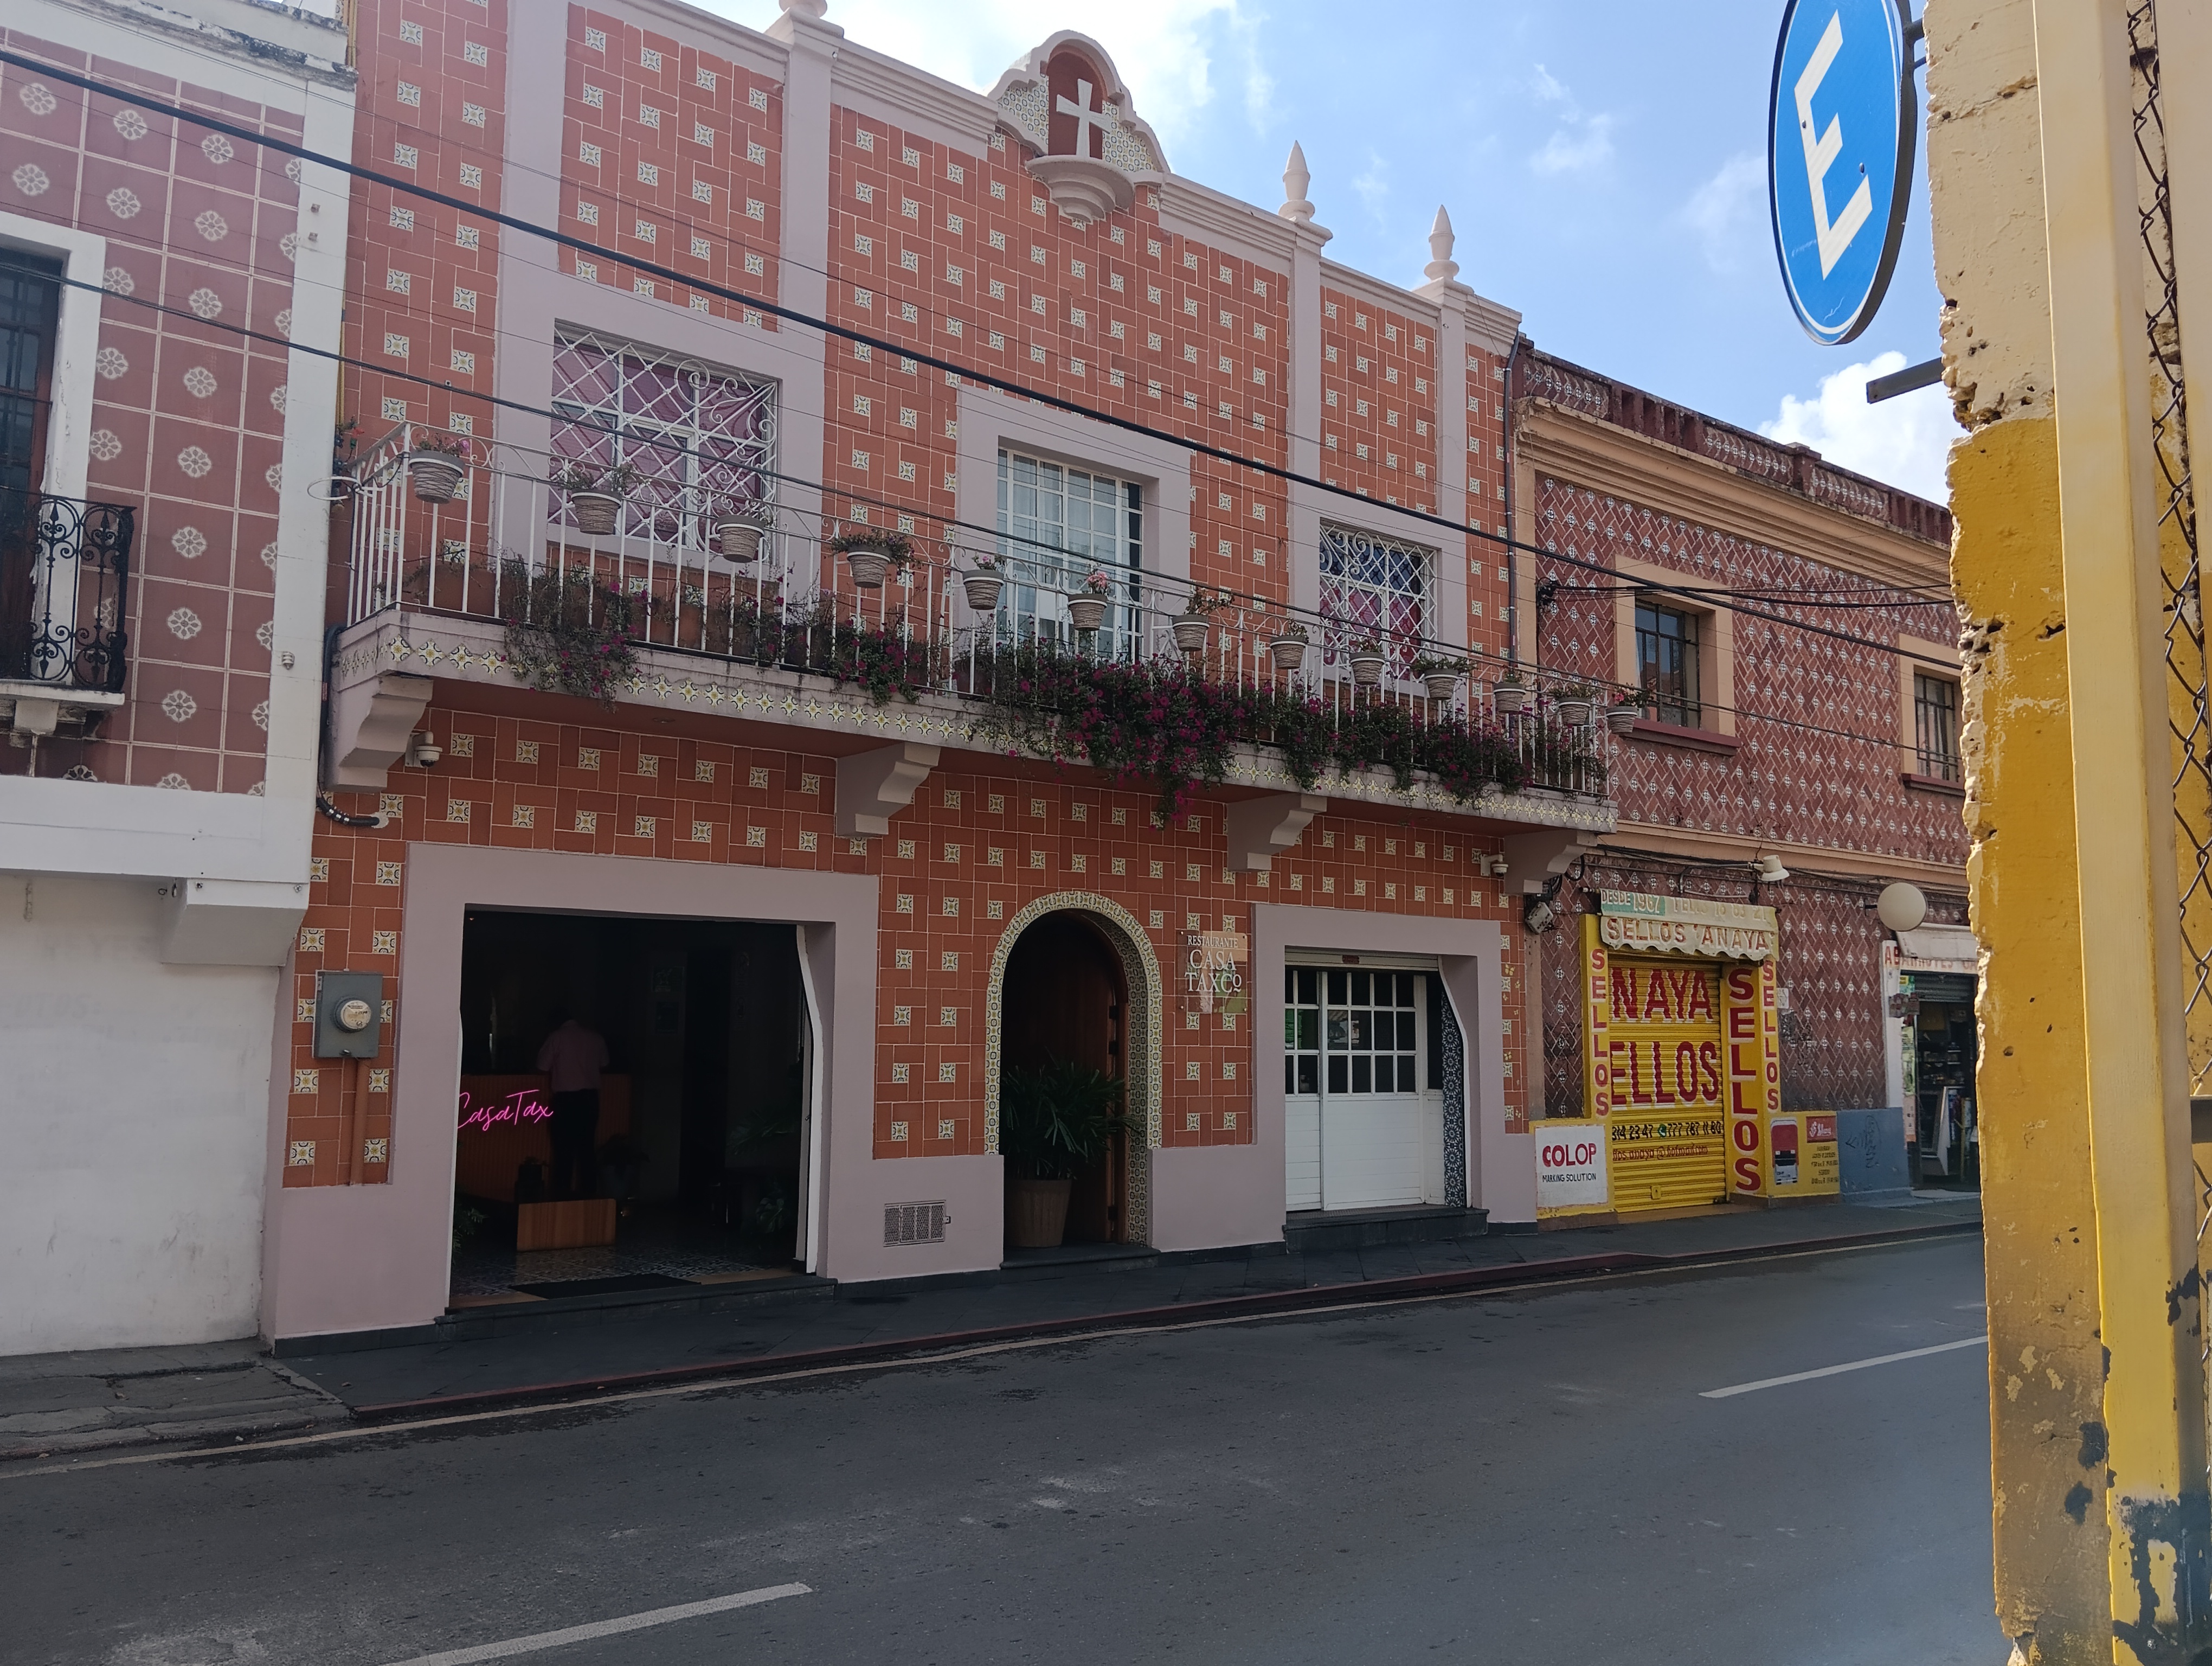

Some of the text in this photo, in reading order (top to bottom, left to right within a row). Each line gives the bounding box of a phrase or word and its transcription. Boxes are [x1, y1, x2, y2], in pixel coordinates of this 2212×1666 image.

[1794, 9, 1873, 280] E
[1601, 889, 1631, 905] DESDE
[1634, 892, 1661, 913] 1967
[1186, 935, 1238, 948] RESTAURANTE
[1606, 918, 1687, 945] SELLOS
[1189, 949, 1237, 970] CASA
[1184, 972, 1242, 993] TAXCO
[1591, 949, 1610, 1117] SELLOS
[1763, 960, 1779, 1110] SELLOS
[1728, 968, 1761, 1191] SELLOS
[1629, 1125, 1641, 1140] 23
[1642, 1124, 1653, 1138] 47
[1668, 1123, 1683, 1137] 777
[1686, 1122, 1700, 1136] 787
[1702, 1122, 1709, 1135] 11
[1542, 1143, 1597, 1168] COLOP
[1542, 1172, 1597, 1182] MARKING SOLUTION
